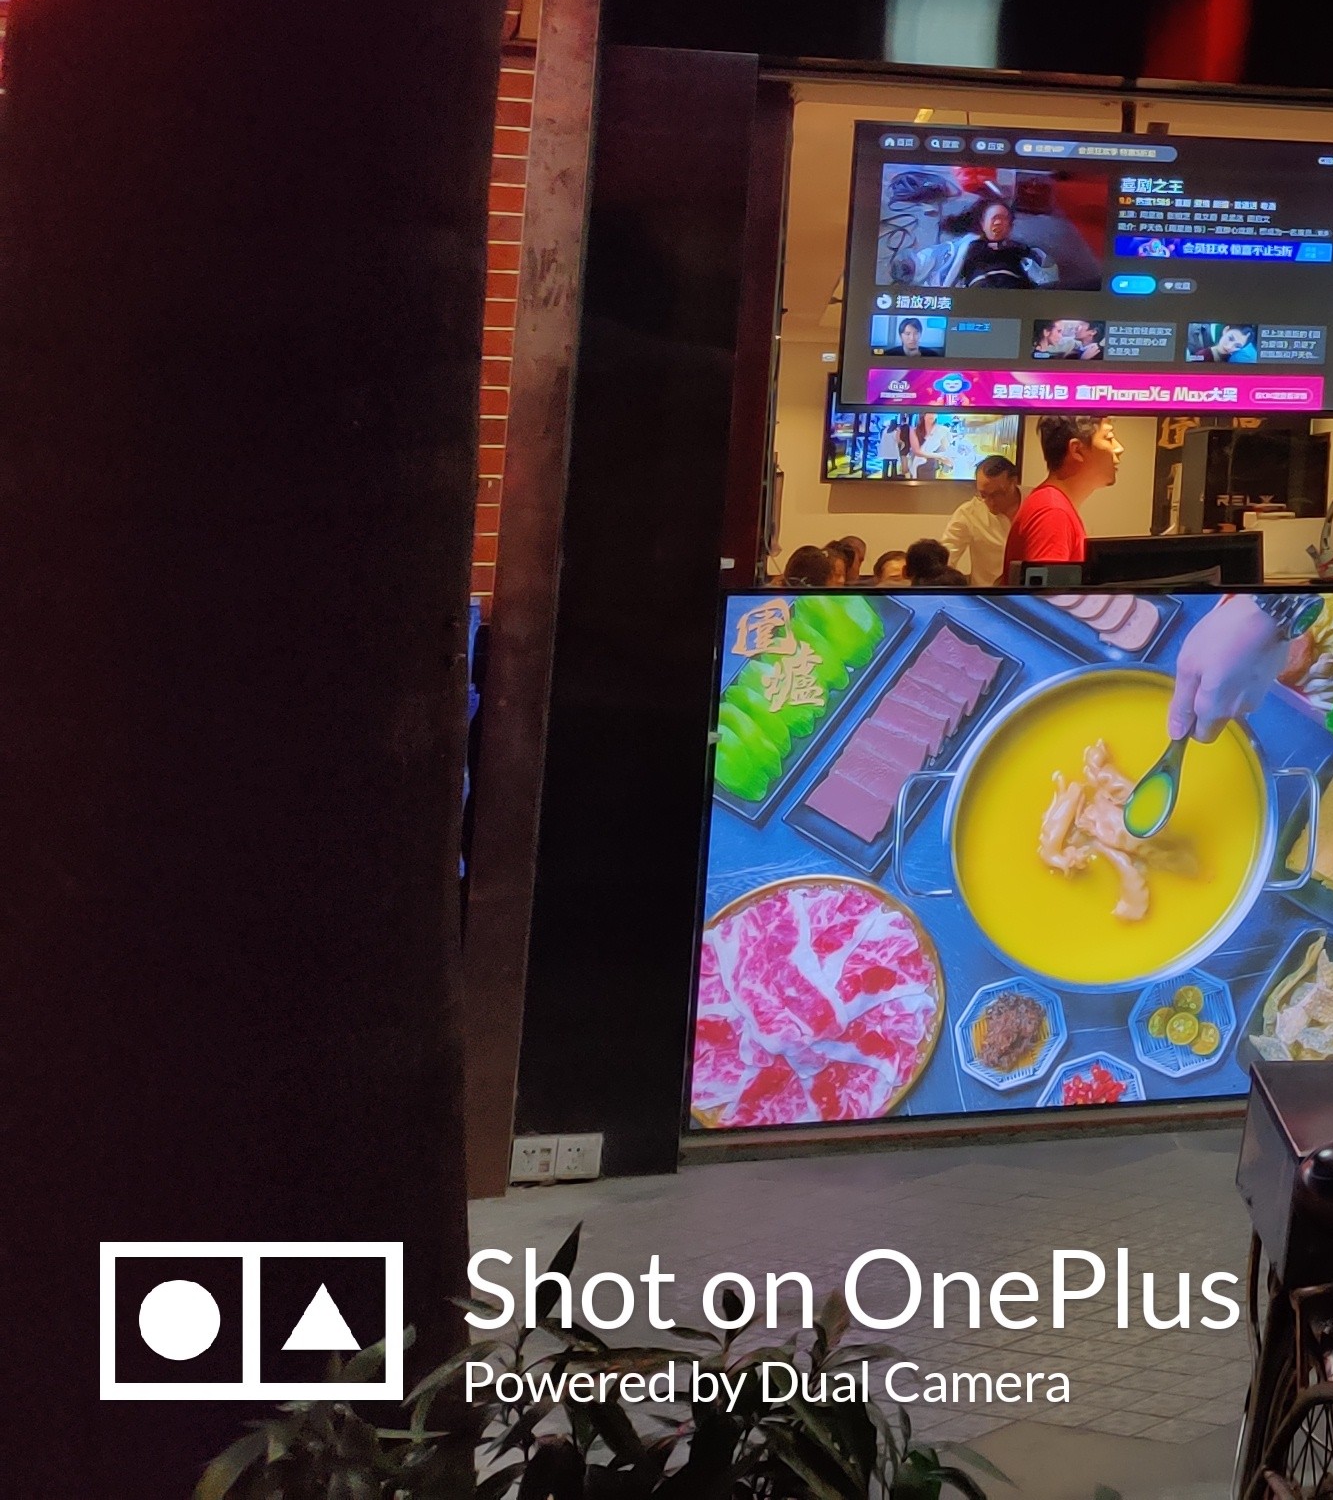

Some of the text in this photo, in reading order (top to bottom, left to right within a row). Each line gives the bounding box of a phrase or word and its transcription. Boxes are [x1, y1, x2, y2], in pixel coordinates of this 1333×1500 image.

[1120, 177, 1184, 194] 喜剧之王
[896, 294, 952, 310] 播放列表
